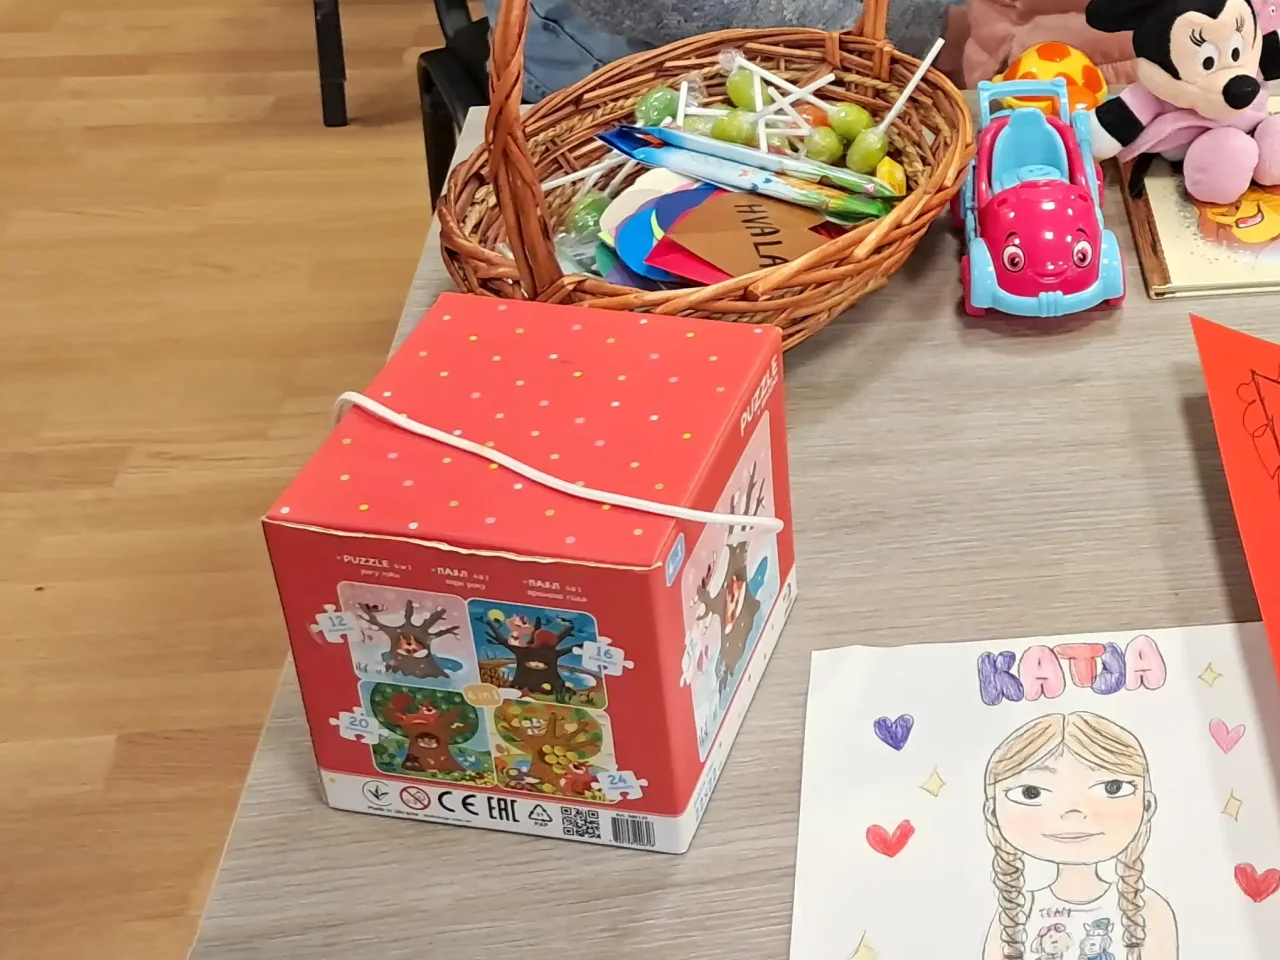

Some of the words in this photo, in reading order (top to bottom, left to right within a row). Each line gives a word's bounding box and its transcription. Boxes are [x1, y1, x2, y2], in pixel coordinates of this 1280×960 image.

[734, 204, 790, 268] HVALA
[740, 353, 778, 437] PUZZLE
[343, 554, 390, 568] PUZZLE
[437, 566, 469, 578] ПАЗЛ
[527, 578, 560, 590] ПАЗЛ
[328, 615, 347, 628] 12
[595, 646, 614, 659] 16
[977, 634, 1167, 706] KATJA
[349, 716, 370, 729] 20
[607, 774, 628, 786] 24
[1038, 907, 1072, 918] TEAM
